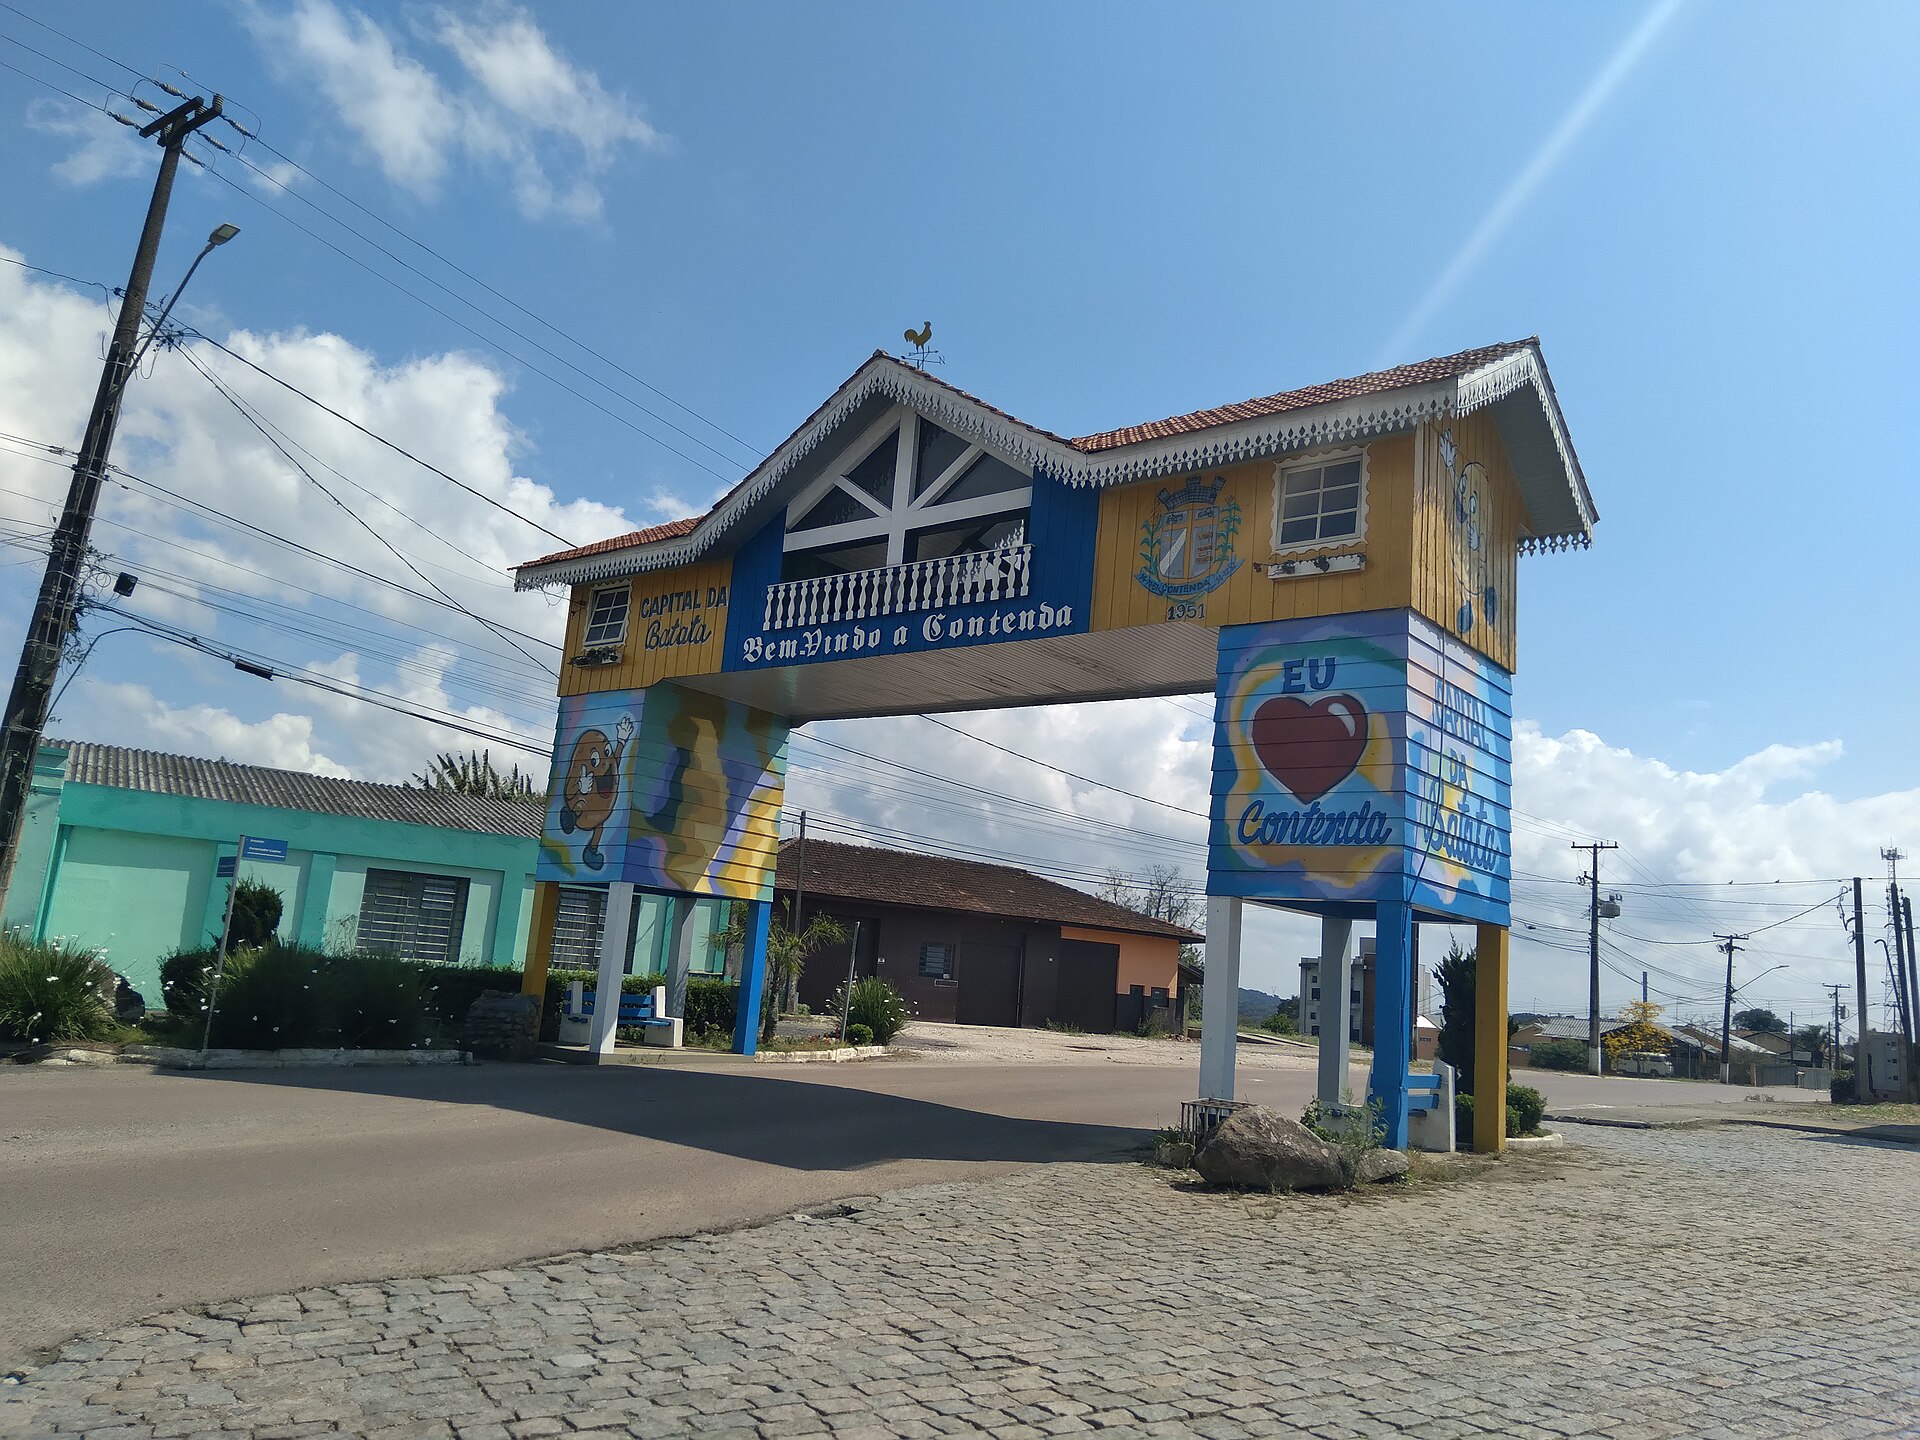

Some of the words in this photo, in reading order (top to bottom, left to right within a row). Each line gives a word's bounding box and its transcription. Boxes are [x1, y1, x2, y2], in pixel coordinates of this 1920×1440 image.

[641, 589, 701, 618] CAPITAL
[707, 586, 727, 609] DA
[1167, 603, 1206, 621] 1951
[645, 614, 713, 650] Batata
[893, 625, 908, 647] a
[922, 601, 1073, 643] Contenda
[1281, 656, 1337, 695] EU
[1434, 679, 1489, 752] CAPITAL
[1449, 747, 1471, 792] DA
[1237, 799, 1393, 846] Contenda
